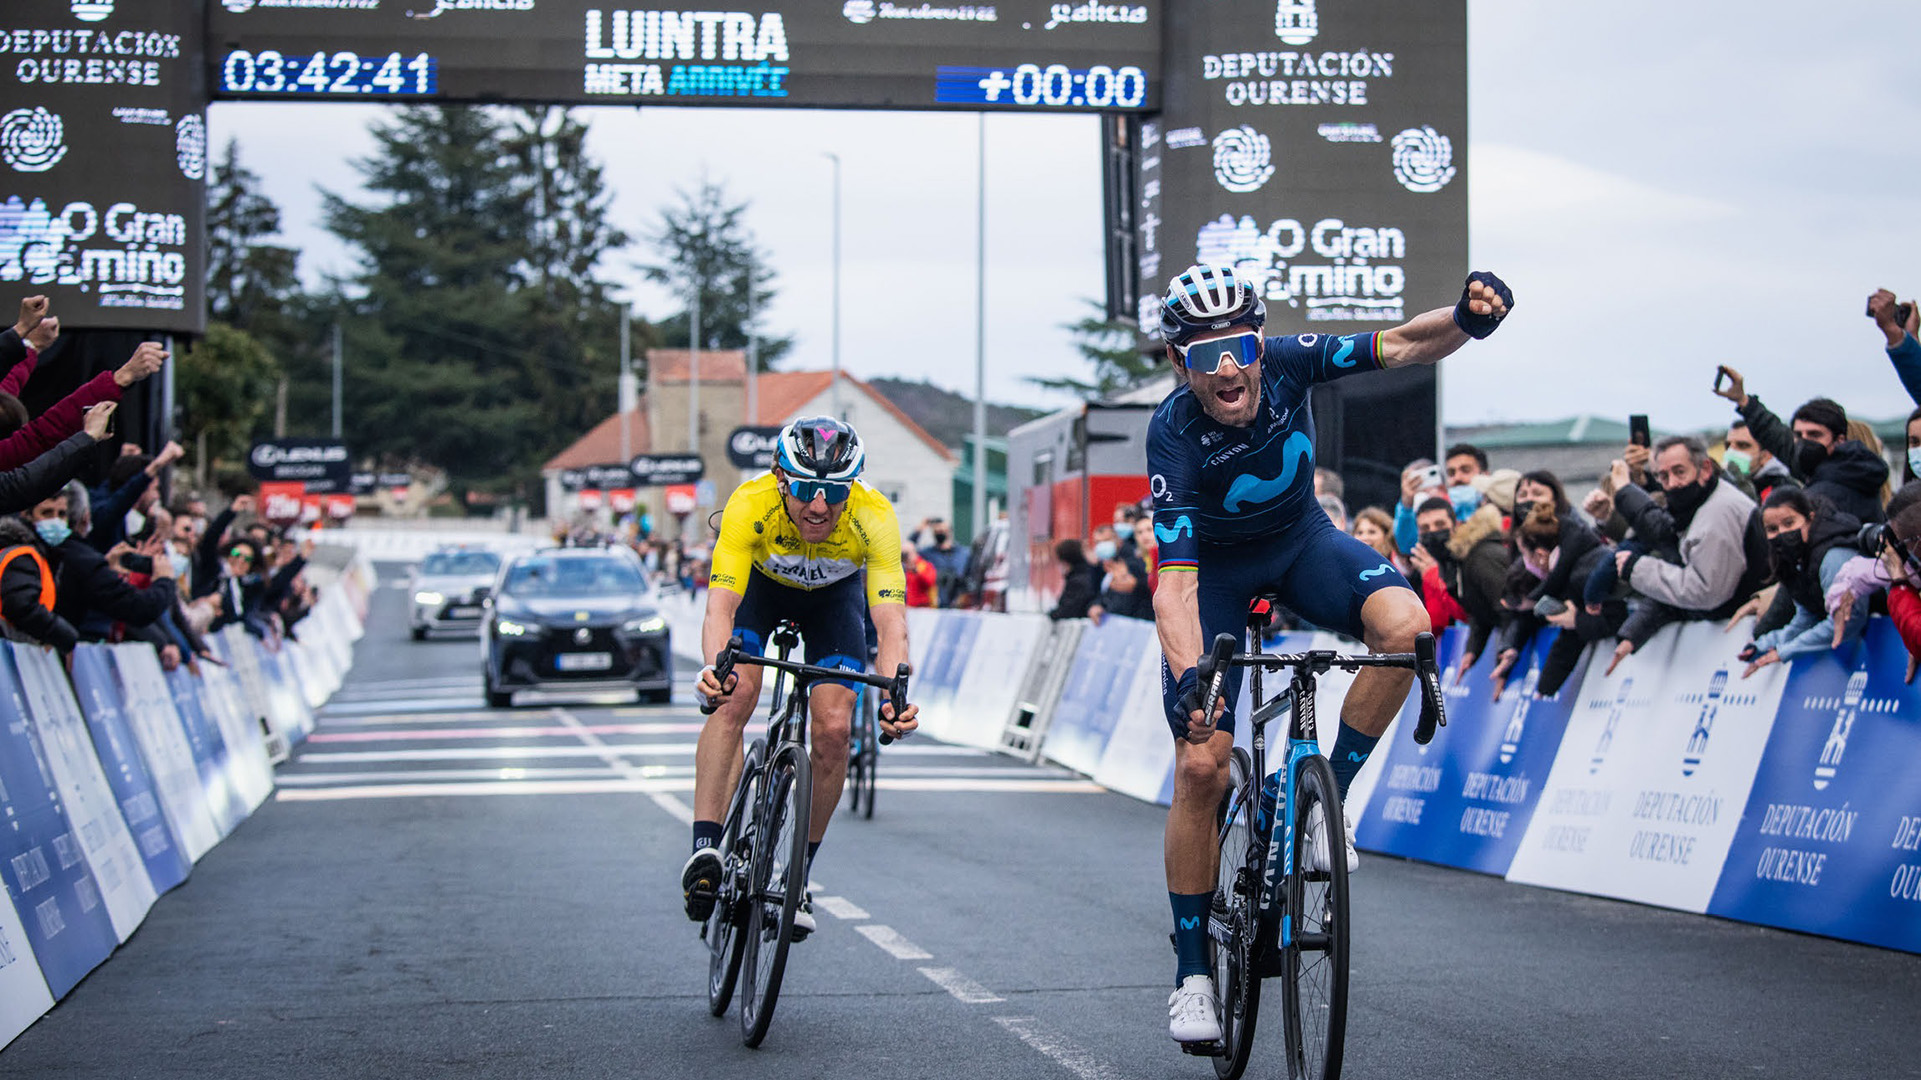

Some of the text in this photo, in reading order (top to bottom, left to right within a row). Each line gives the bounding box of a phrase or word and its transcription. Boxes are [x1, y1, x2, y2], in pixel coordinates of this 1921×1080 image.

[585, 9, 789, 61] LUINTRA
[16, 58, 161, 86] OURENSE
[224, 50, 429, 94] 03:42:41
[584, 63, 664, 95] META
[978, 63, 1146, 107] +00:00
[1225, 80, 1368, 106] OURENSE
[61, 201, 186, 246] O Gran
[1268, 218, 1405, 258] O Gran
[1205, 671, 1222, 714] SRAM
[1760, 802, 1858, 843] DEPUTACIÓN
[1756, 847, 1827, 886] OURENSE
